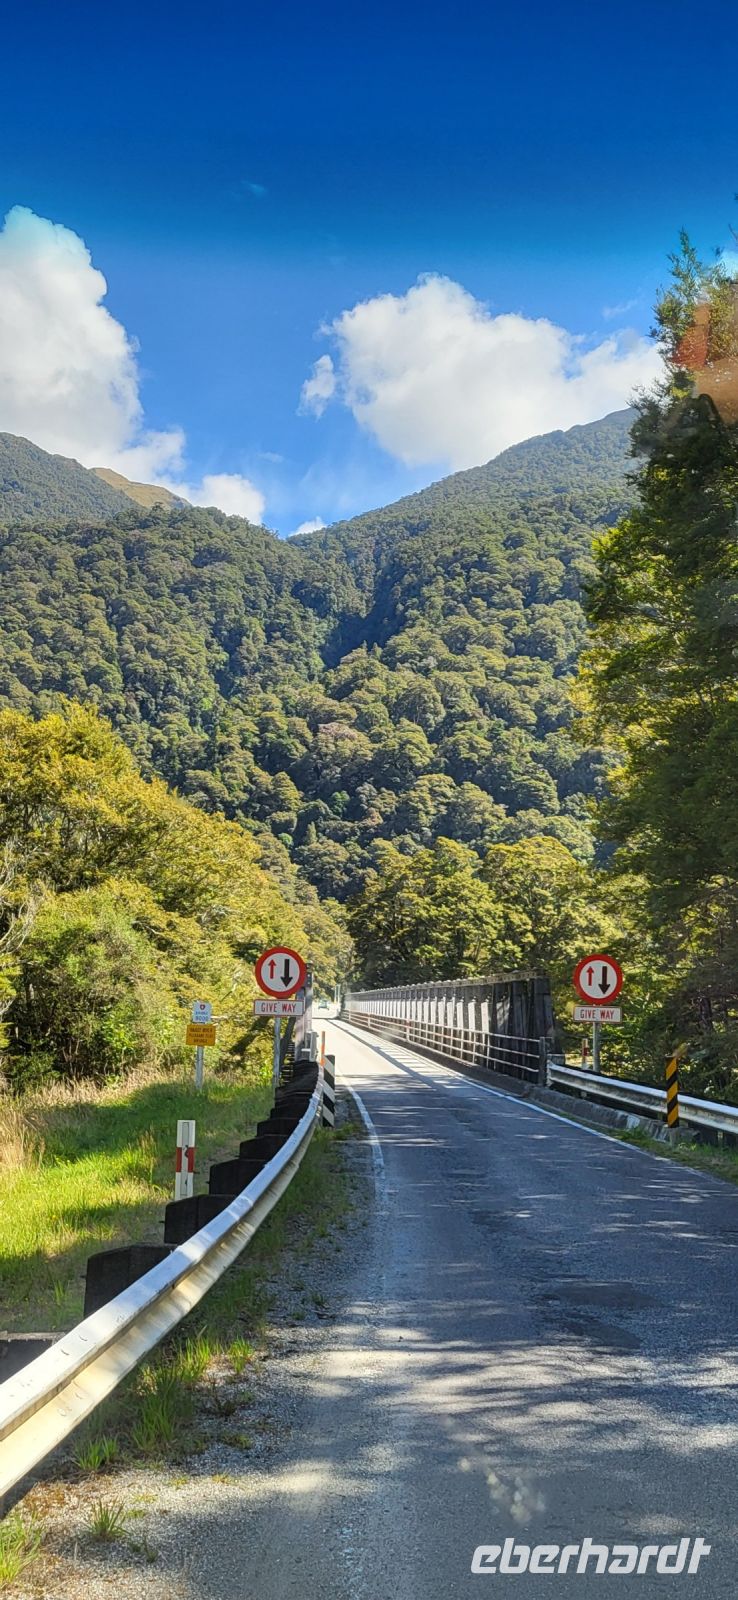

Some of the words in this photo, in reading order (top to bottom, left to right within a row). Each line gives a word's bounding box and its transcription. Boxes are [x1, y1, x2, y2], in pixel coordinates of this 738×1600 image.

[260, 1002, 278, 1013] GIVE
[281, 1003, 297, 1013] WAY
[579, 1009, 597, 1019] GIVE
[599, 1010, 615, 1020] WAY
